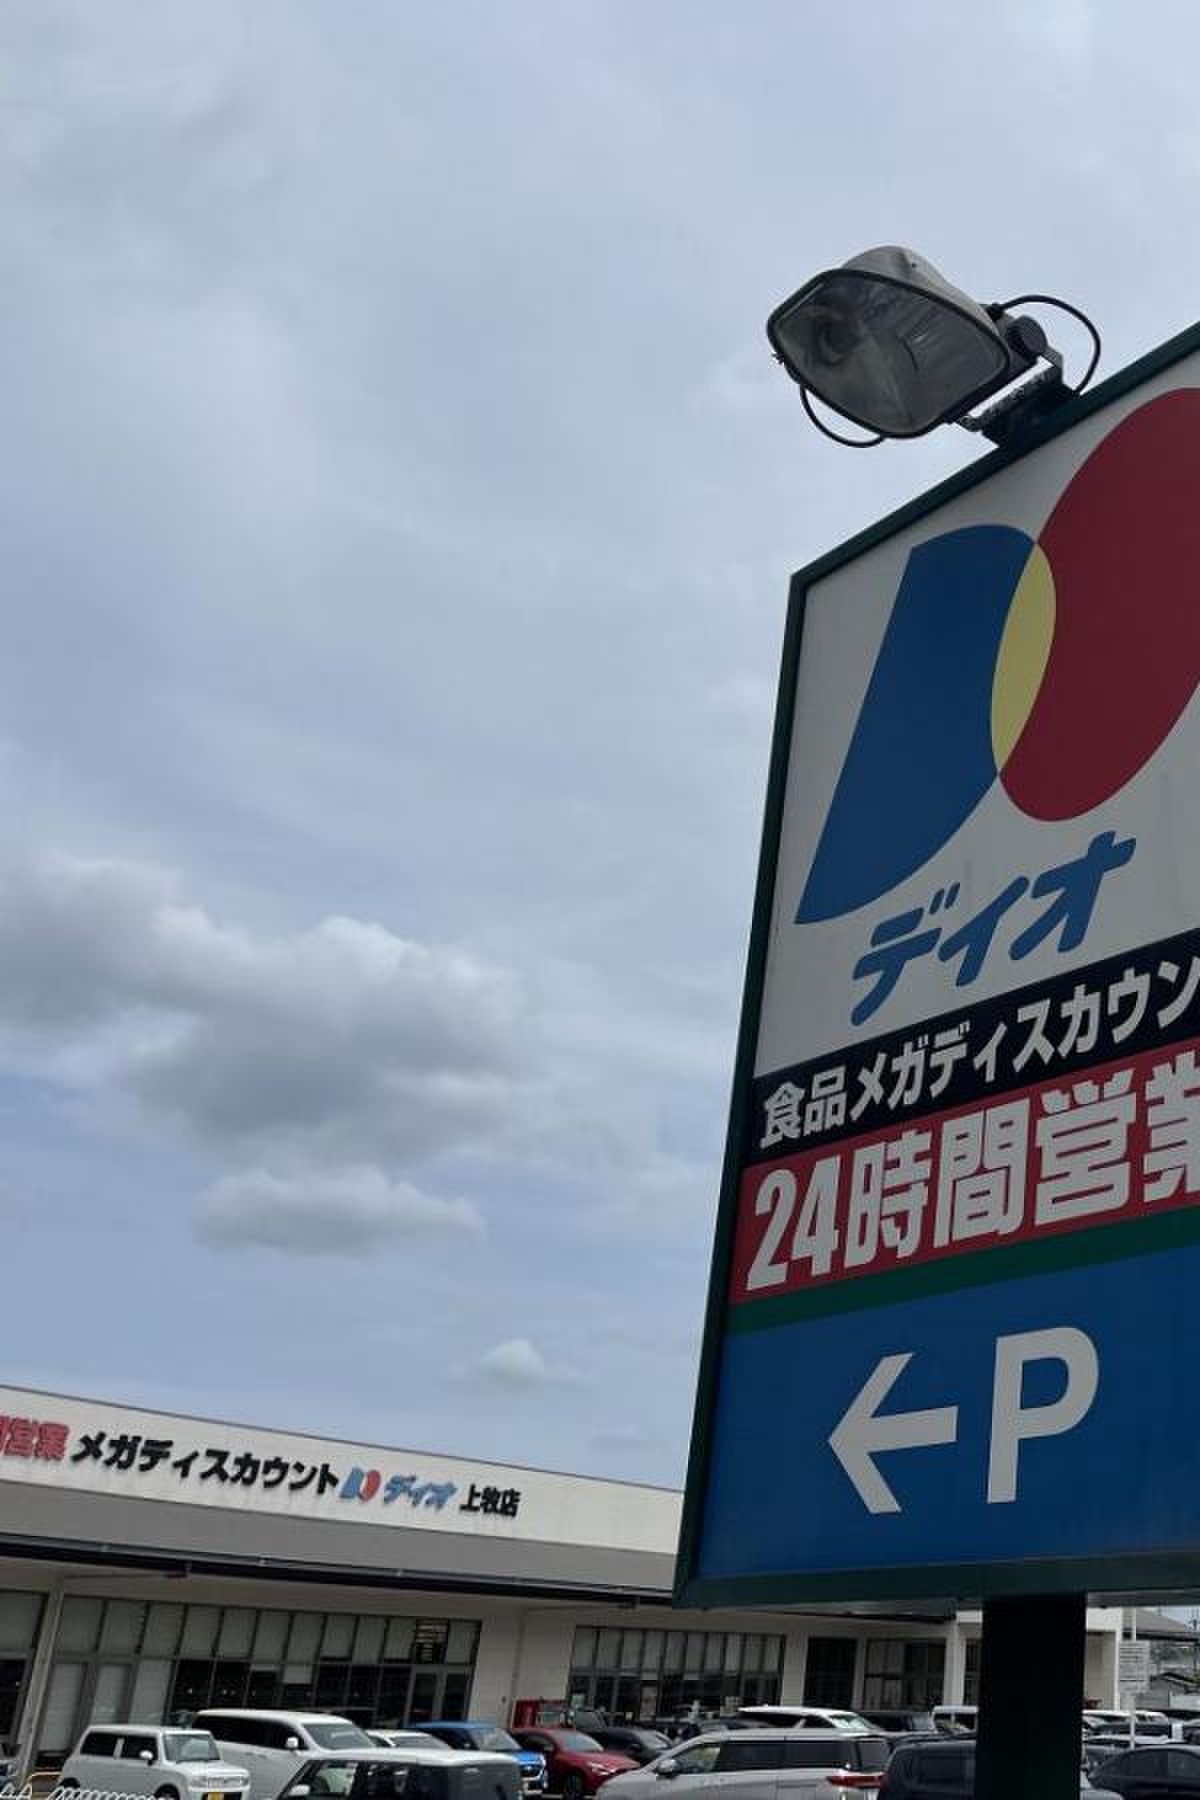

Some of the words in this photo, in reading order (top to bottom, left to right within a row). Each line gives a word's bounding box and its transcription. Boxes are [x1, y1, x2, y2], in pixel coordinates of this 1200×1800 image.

[852, 831, 1136, 1025] ディオ
[71, 1432, 339, 1494] メガディスカウント
[987, 1327, 1099, 1504] P
